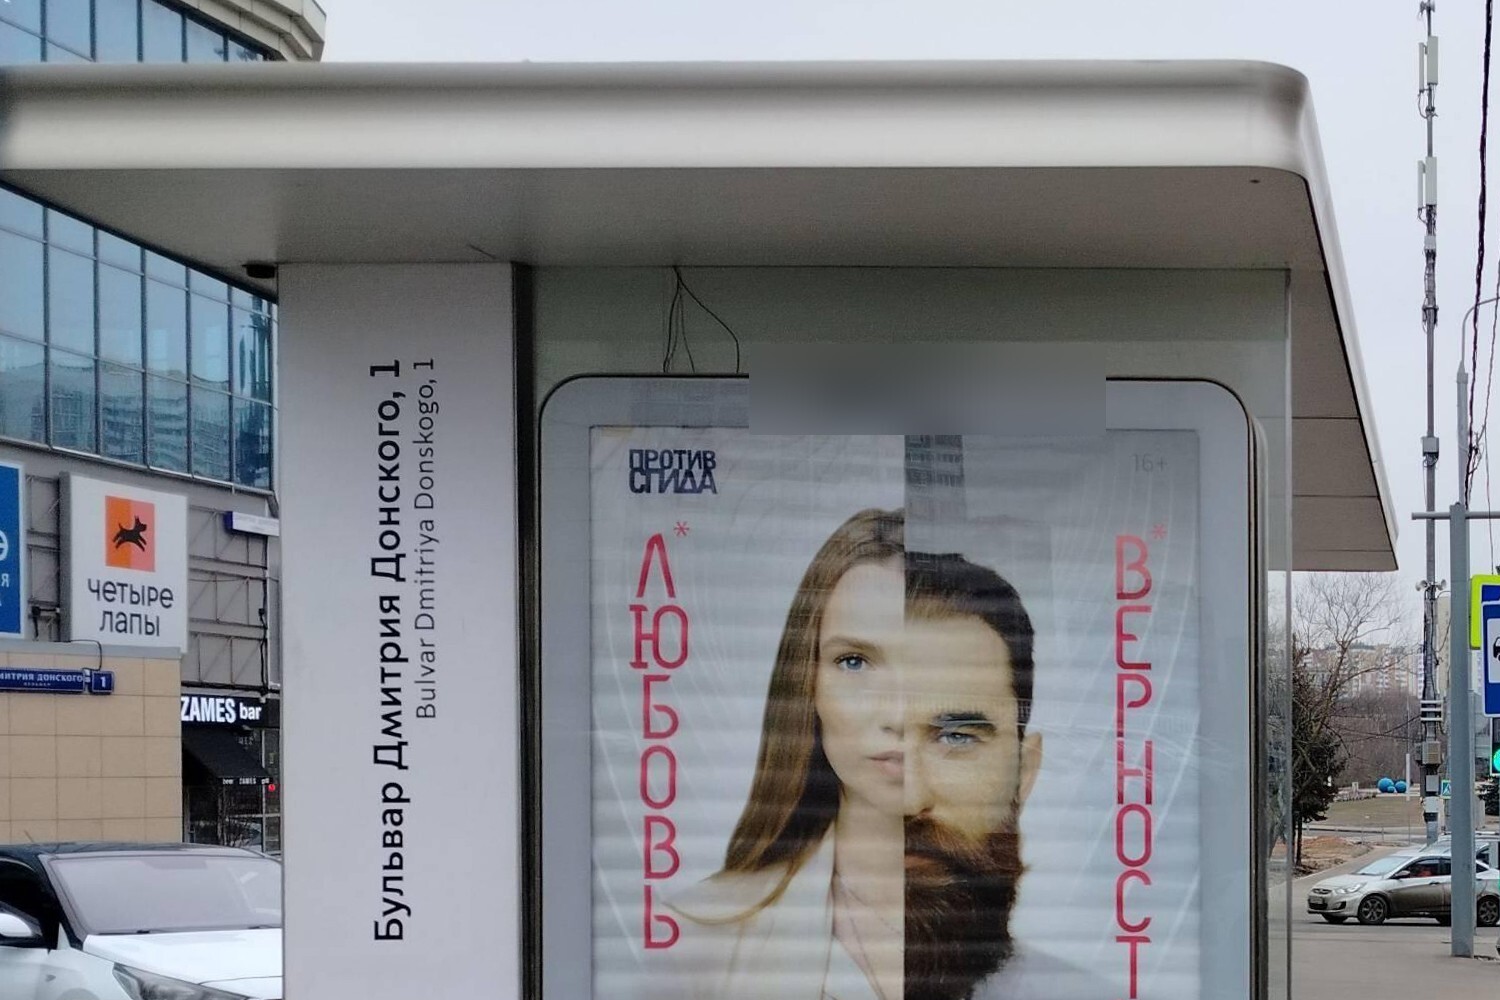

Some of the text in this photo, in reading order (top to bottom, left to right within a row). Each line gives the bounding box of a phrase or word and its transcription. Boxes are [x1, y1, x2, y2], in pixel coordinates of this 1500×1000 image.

[629, 448, 717, 470] ПРОТИВ
[1129, 453, 1169, 473] 16+
[629, 468, 718, 494] СПИДА
[412, 358, 440, 719] Bulvar Dmitriya Donskogo, 1
[87, 578, 174, 609] четыре
[99, 610, 160, 637] лапы
[369, 359, 411, 941] Бульвар Дмитрия Донского, 1
[36, 673, 83, 683] ДОНСКОГО
[99, 676, 107, 688] 1
[181, 696, 262, 723] ZAMES bar
